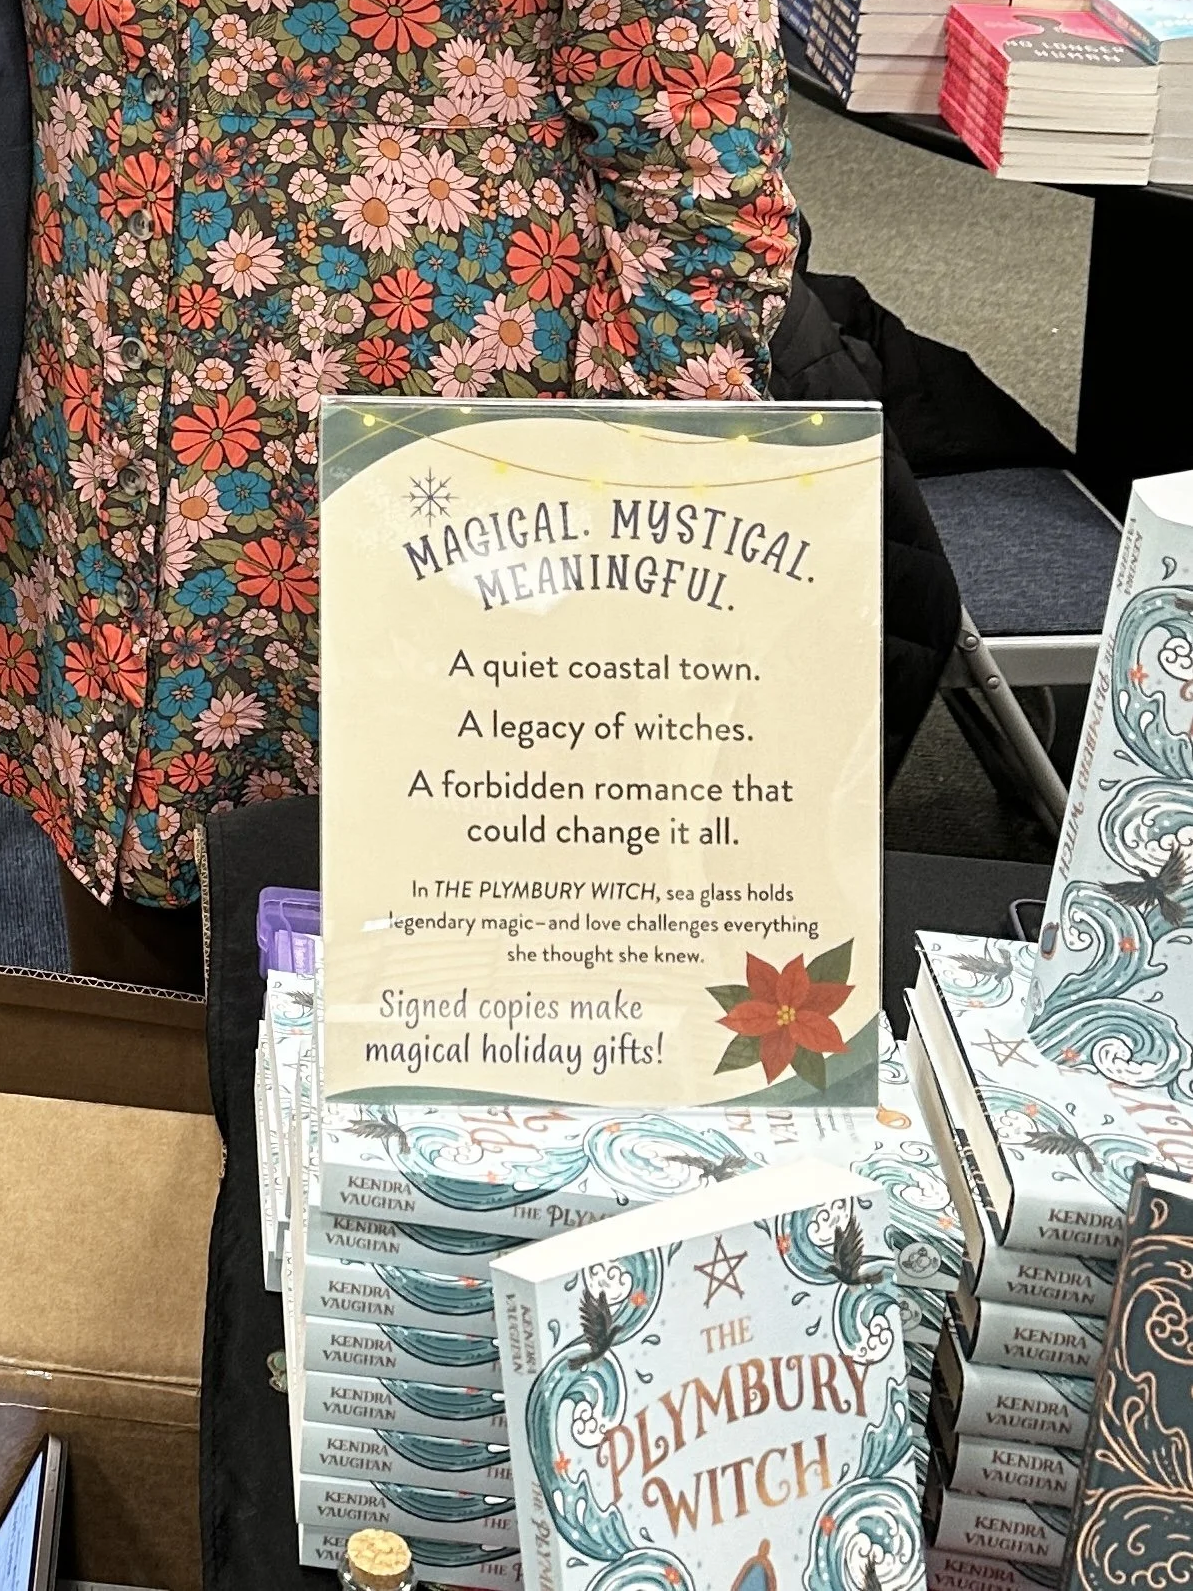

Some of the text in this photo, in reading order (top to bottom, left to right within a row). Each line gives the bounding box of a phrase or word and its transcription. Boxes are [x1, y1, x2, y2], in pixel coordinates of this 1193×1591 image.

[402, 499, 816, 583] MAGICAL. MYSTICAL.
[473, 553, 734, 611] MEANINGFUL.
[448, 649, 760, 688] A quiet coastal town.
[458, 709, 753, 750] A legacy of witches.
[1080, 669, 1111, 793] PLYMBURY
[408, 769, 793, 802] A forbidden romance that
[467, 814, 738, 855] could change it all.
[1060, 800, 1086, 882] WITCH
[413, 880, 794, 908] In THE PLYMBURY WITCH, sea glass holds
[388, 911, 475, 935] legendary
[586, 913, 621, 931] love
[627, 913, 718, 938] challenges
[724, 915, 819, 940] everything
[507, 944, 704, 969] she thought she knew.
[380, 988, 642, 1030] Signed copies make
[366, 1031, 663, 1075] magical holiday gifts!
[347, 1174, 413, 1196] KENDRA
[339, 1192, 416, 1213] VAUGHAN
[512, 1204, 542, 1221] THE
[333, 1215, 398, 1238] KENDRA
[1047, 1208, 1124, 1230] KENDRA
[325, 1232, 401, 1254] VAUGHAN
[1038, 1225, 1123, 1248] VAUGHAN
[1017, 1264, 1093, 1289] KENDRA
[328, 1279, 392, 1300] KENDRA
[1006, 1280, 1096, 1306] VAUGHAN
[320, 1296, 395, 1317] VAUGHAN
[330, 1333, 394, 1353] KENDRA
[700, 1315, 754, 1354] THE
[1013, 1326, 1088, 1350] KENDRA
[322, 1349, 397, 1369] VAUGHAN
[1003, 1343, 1092, 1367] VAUGHAN
[330, 1386, 393, 1406] KENDRA
[995, 1395, 1070, 1418] KENDRA
[322, 1401, 397, 1421] VAUGHAN
[985, 1411, 1073, 1435] VAUGHAN
[596, 1352, 871, 1505] PLYMBURY
[327, 1437, 390, 1457] KENDRA
[319, 1453, 393, 1473] VAUGHAN
[991, 1449, 1066, 1475] KENDRA
[641, 1433, 834, 1539] WITCH
[982, 1467, 1069, 1493] VAUGHAN
[324, 1490, 387, 1509] KENDRA
[317, 1505, 391, 1524] VAUGHAN
[482, 1517, 512, 1530] THE
[974, 1515, 1047, 1540] KENDRA
[964, 1531, 1050, 1557] VAUGHAN
[480, 1564, 508, 1576] THE
[944, 1558, 1016, 1584] KENDRA
